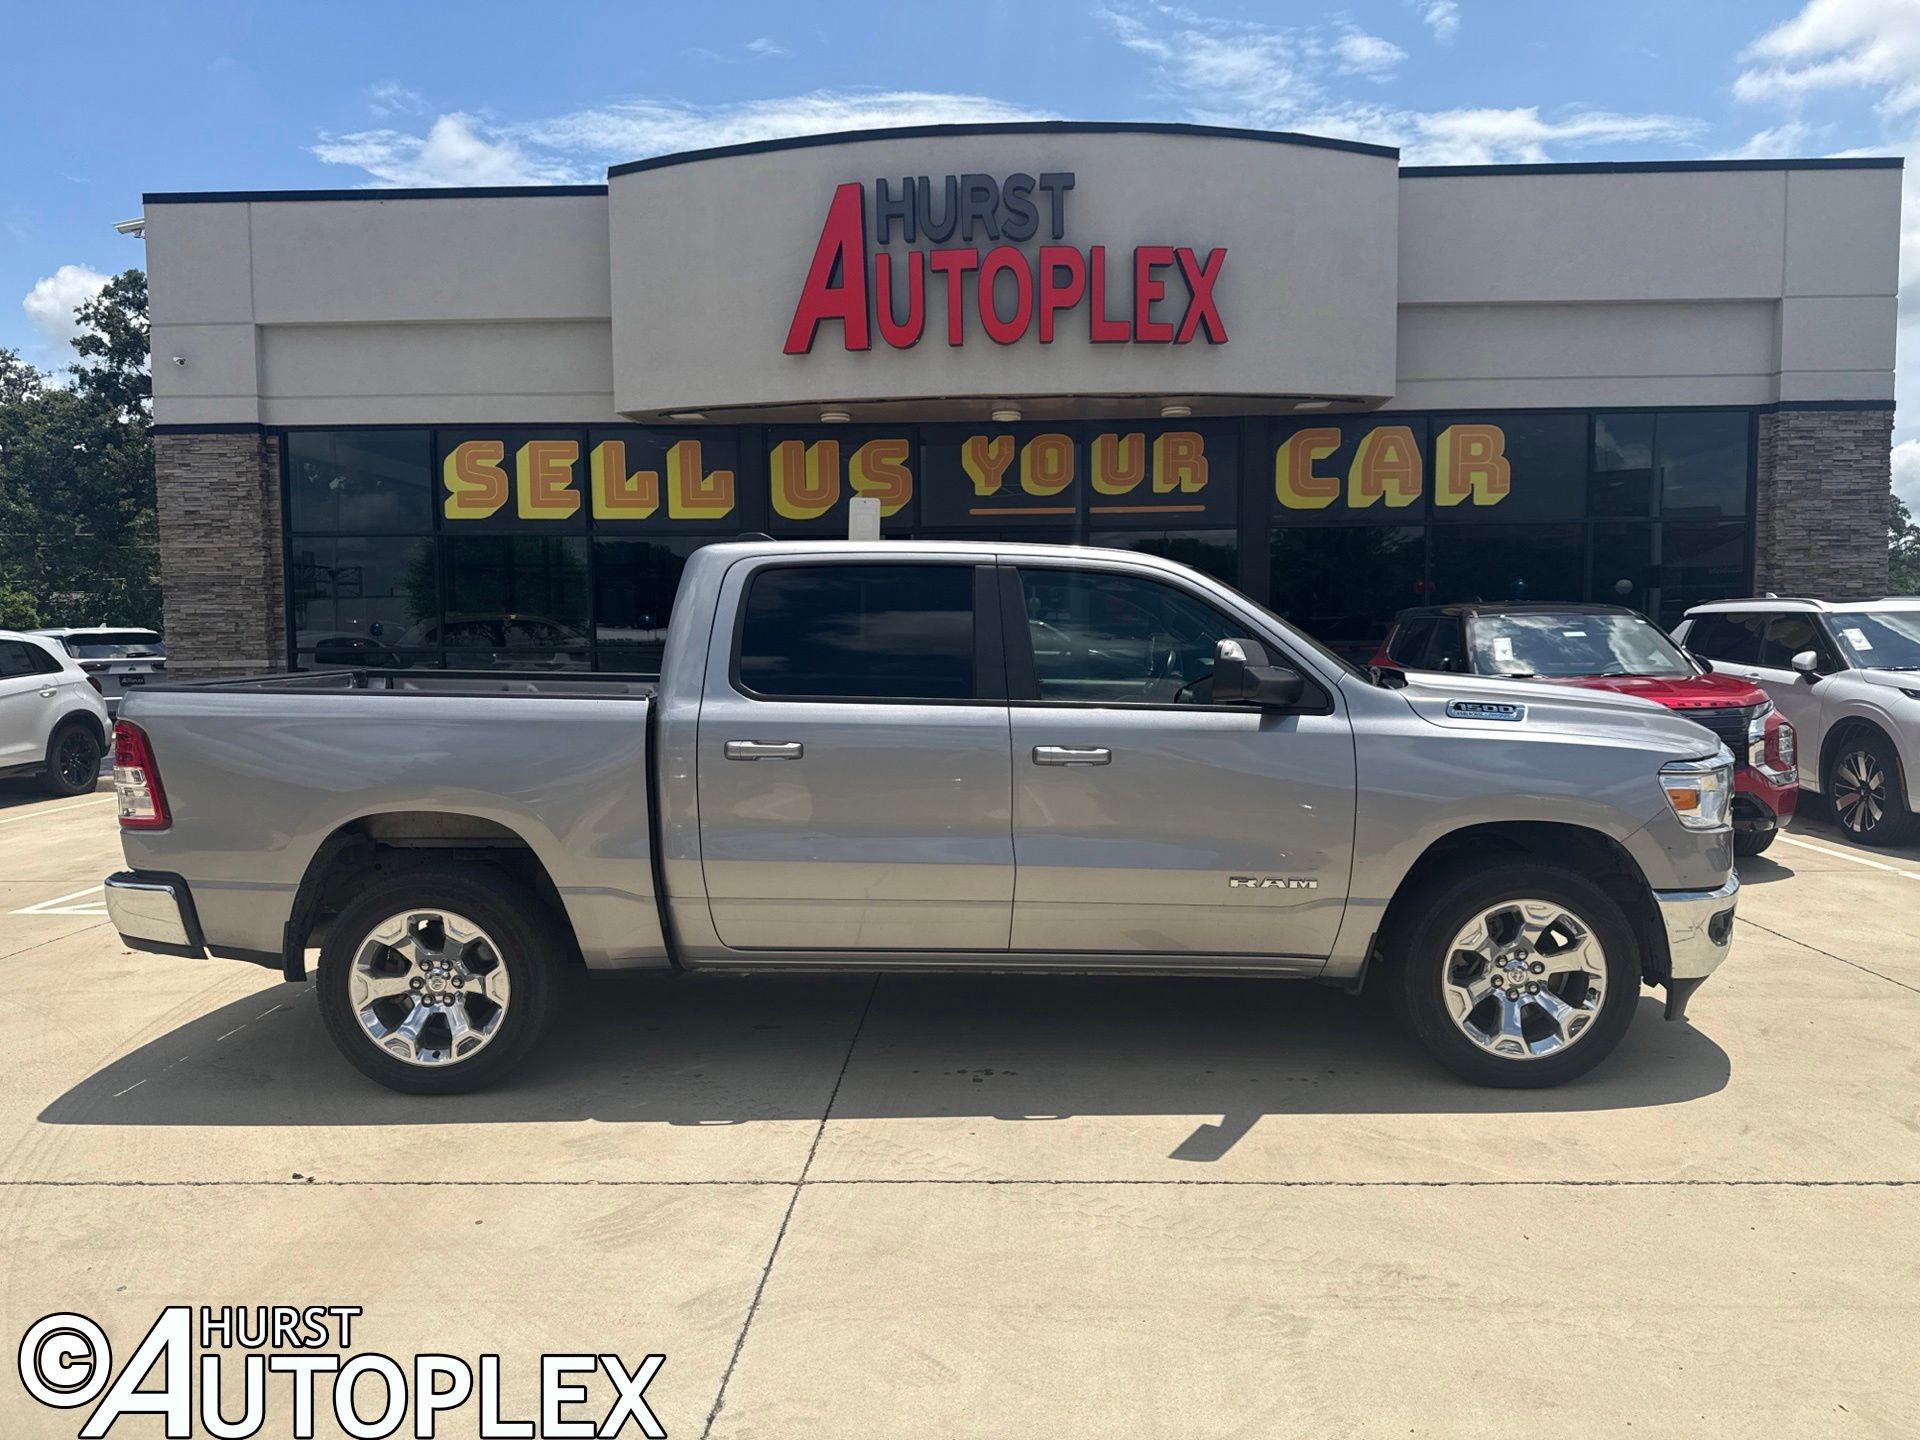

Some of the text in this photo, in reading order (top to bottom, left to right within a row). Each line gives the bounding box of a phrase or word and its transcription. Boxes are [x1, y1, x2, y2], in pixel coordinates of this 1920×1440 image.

[875, 172, 1075, 245] HURST
[782, 181, 1229, 355] AUTOPLEX
[443, 424, 1511, 520] SELL US YOUR CAR
[1457, 703, 1514, 713] 1500
[1229, 877, 1318, 889] RAM
